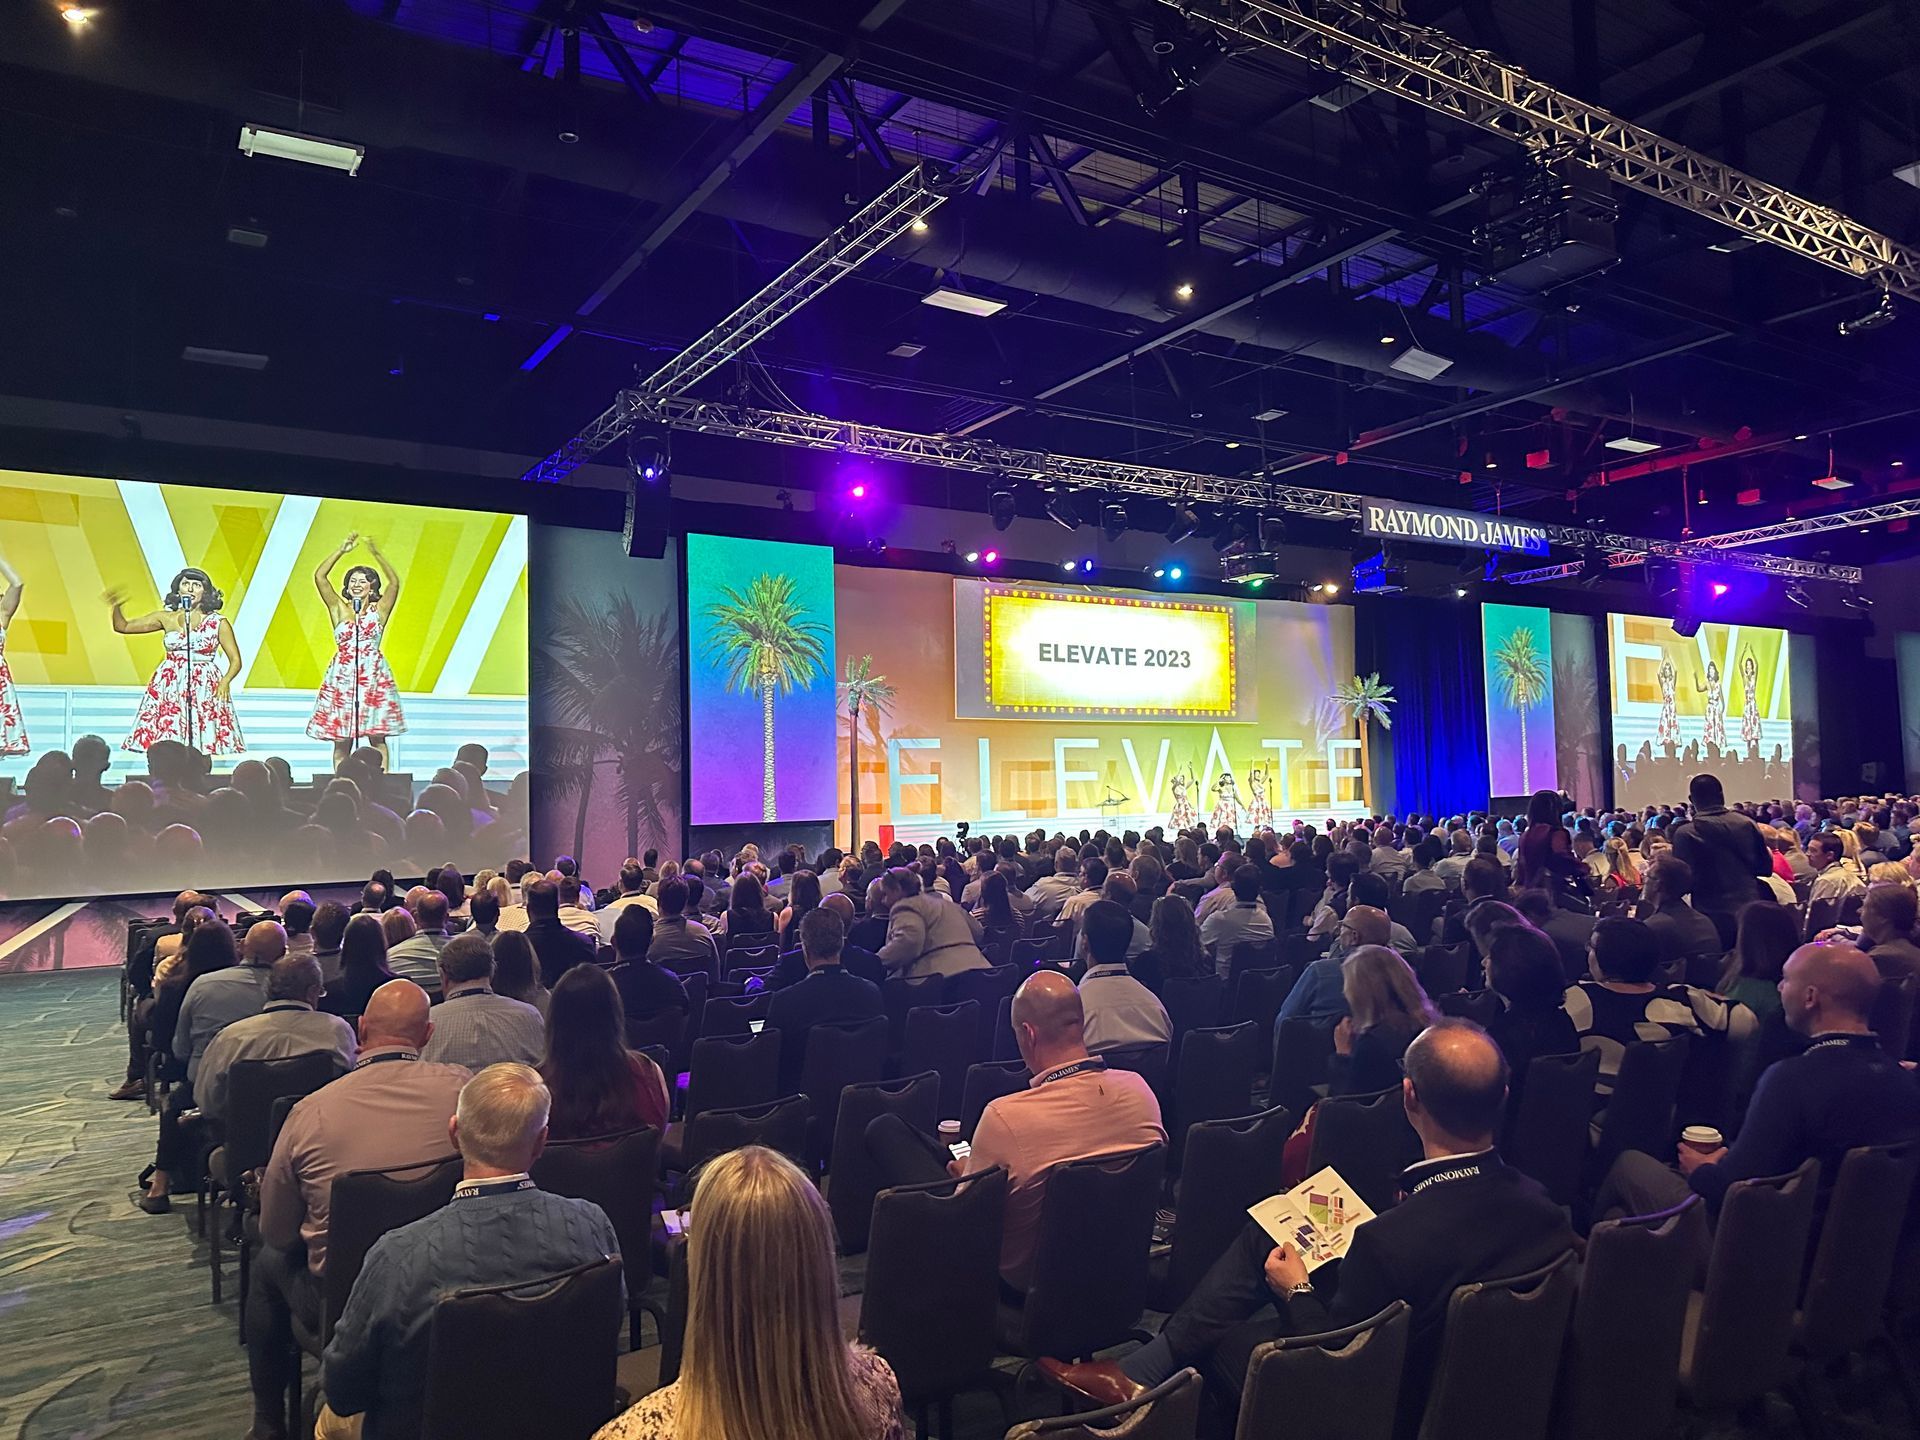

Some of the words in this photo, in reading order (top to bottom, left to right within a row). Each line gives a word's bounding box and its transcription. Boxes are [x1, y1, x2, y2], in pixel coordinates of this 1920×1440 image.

[1368, 506, 1478, 542] RAYMOND
[1039, 643, 1137, 666] ELEVATE
[1144, 649, 1191, 668] 2023
[888, 726, 1366, 823] ELEVATE
[1434, 1166, 1480, 1182] RAYMOND
